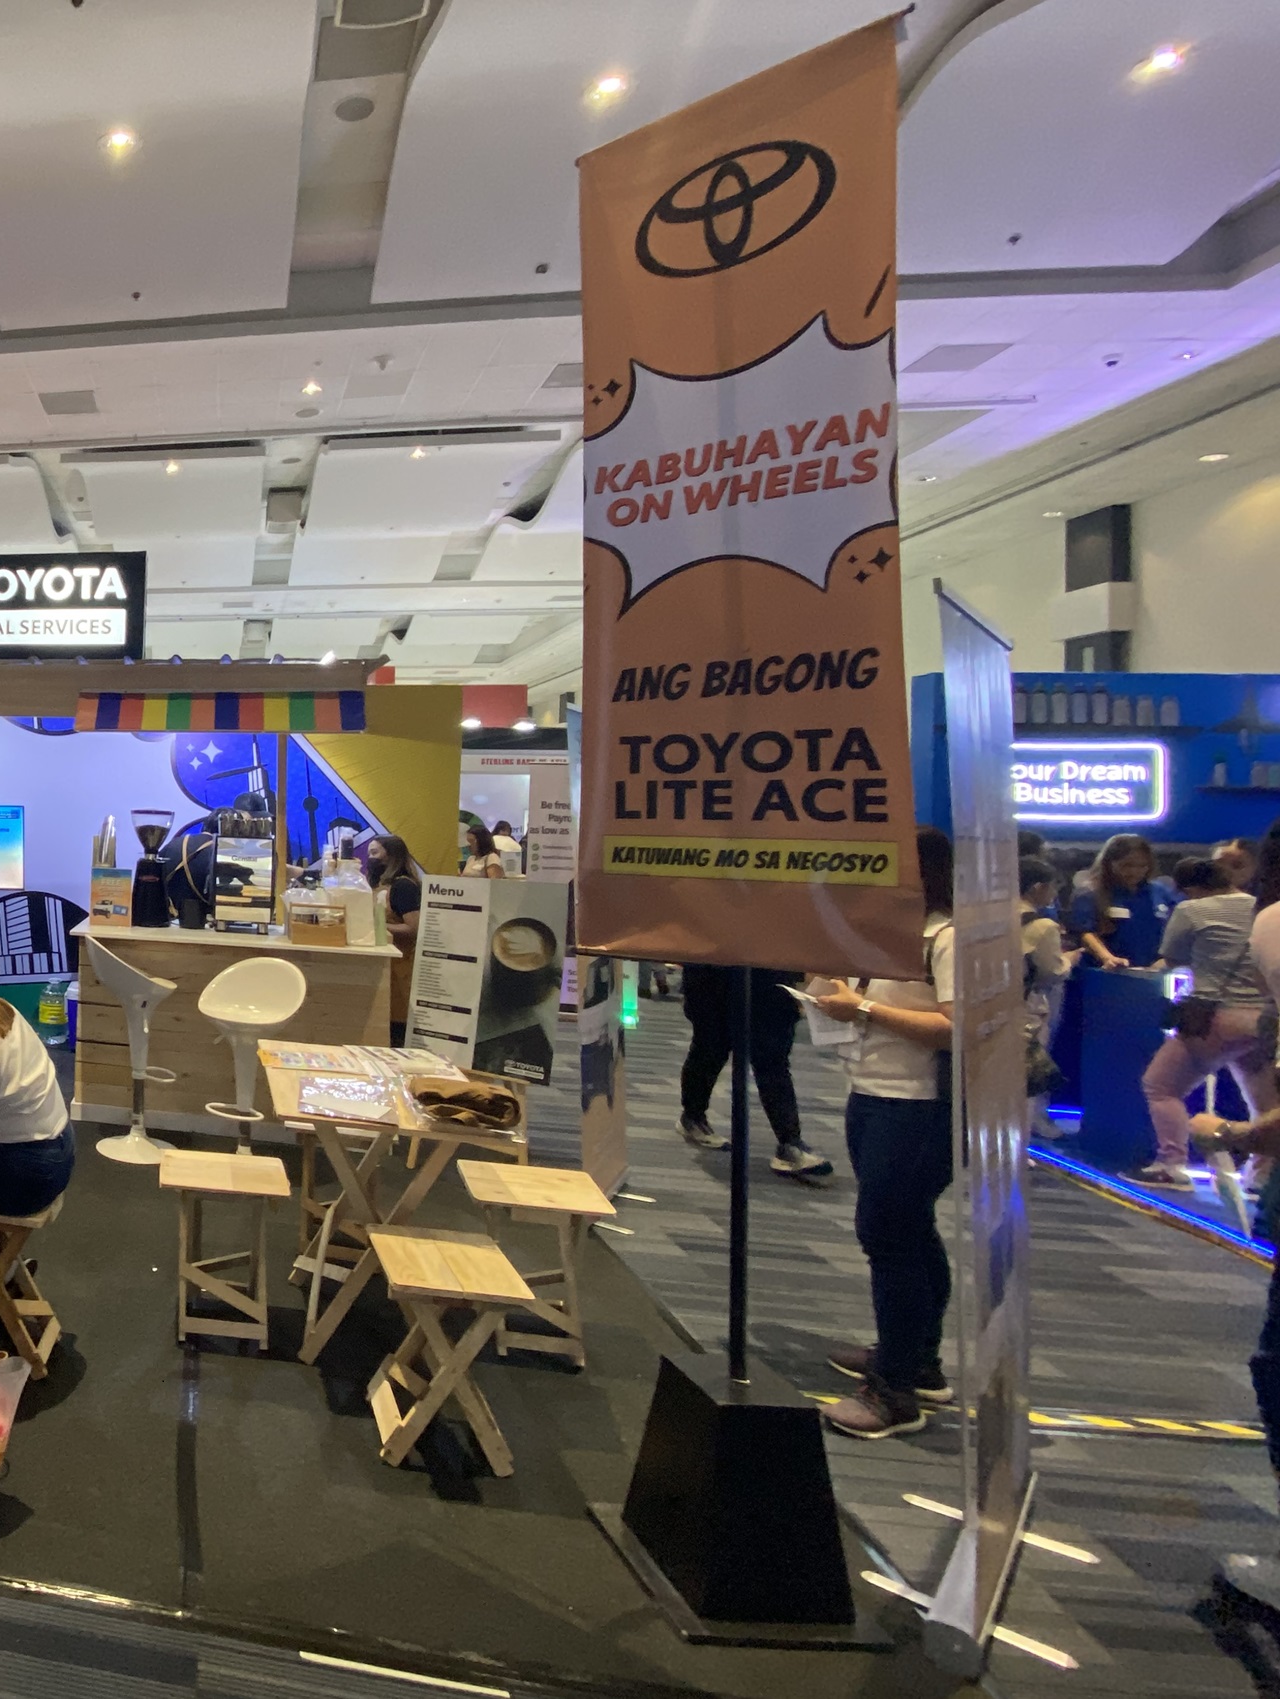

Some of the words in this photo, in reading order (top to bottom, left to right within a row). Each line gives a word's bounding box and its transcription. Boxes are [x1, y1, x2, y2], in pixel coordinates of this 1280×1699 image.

[593, 402, 891, 495] KABUHAYAN
[606, 490, 673, 527] ON
[683, 449, 879, 515] WHEELS
[20, 619, 112, 635] SERVICES
[612, 663, 692, 702] ANG
[700, 647, 880, 698] BAGONG
[619, 727, 882, 774] TOYOTA
[1059, 761, 1148, 782] Dream
[541, 801, 553, 809] Be
[615, 780, 733, 821] LITE
[751, 778, 889, 823] ACE
[1013, 782, 1132, 805] Business
[541, 826, 557, 835] low
[559, 827, 570, 835] as
[611, 846, 710, 867] KATUWANG
[714, 850, 749, 868] MO
[754, 851, 781, 869] SA
[785, 852, 889, 874] NEGOSYO
[428, 883, 464, 897] Menu
[515, 1061, 544, 1072] TOYOTA
